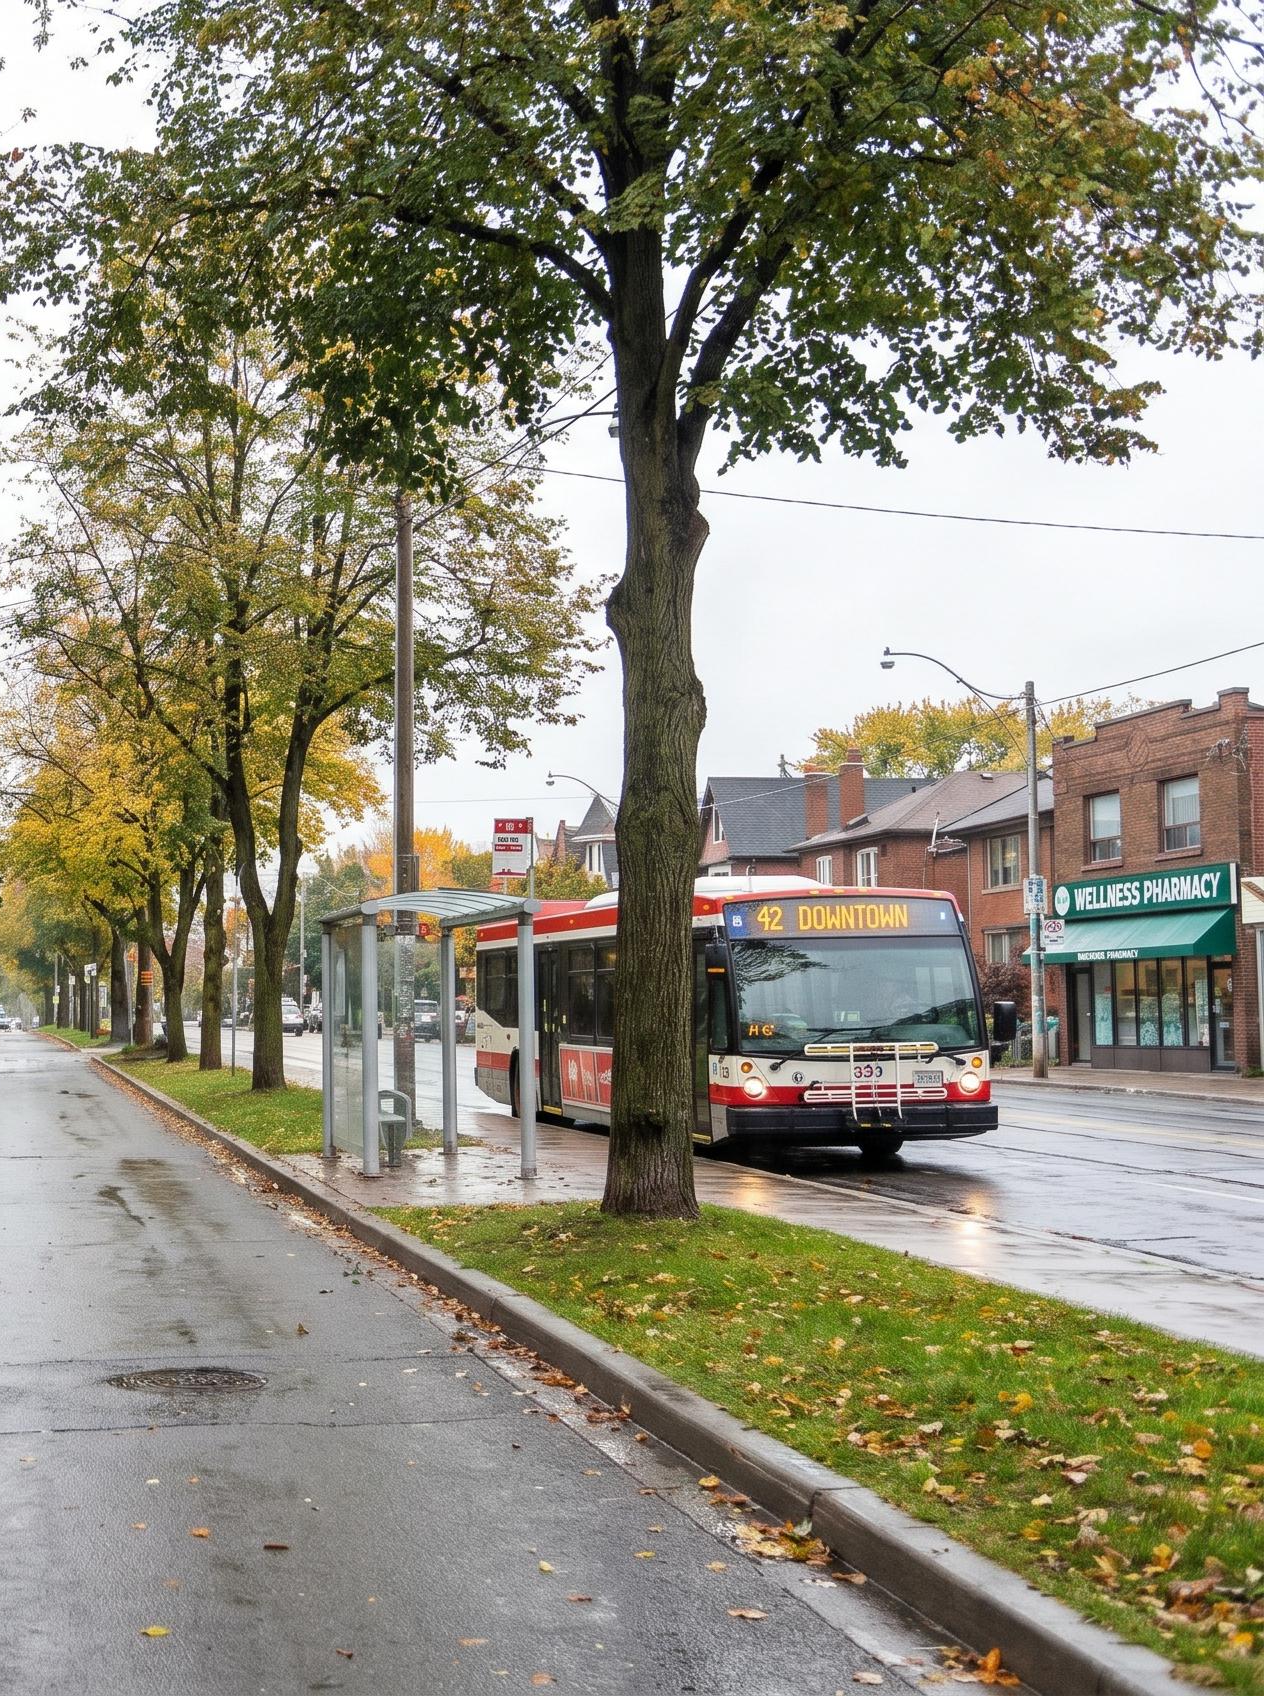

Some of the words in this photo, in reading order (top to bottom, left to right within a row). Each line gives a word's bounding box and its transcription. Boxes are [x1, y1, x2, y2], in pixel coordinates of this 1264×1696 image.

[1074, 881, 1140, 911] WELLNESS
[1144, 871, 1221, 904] PHARMACY
[757, 905, 783, 931] 42
[798, 904, 909, 930] DOWNTOWN
